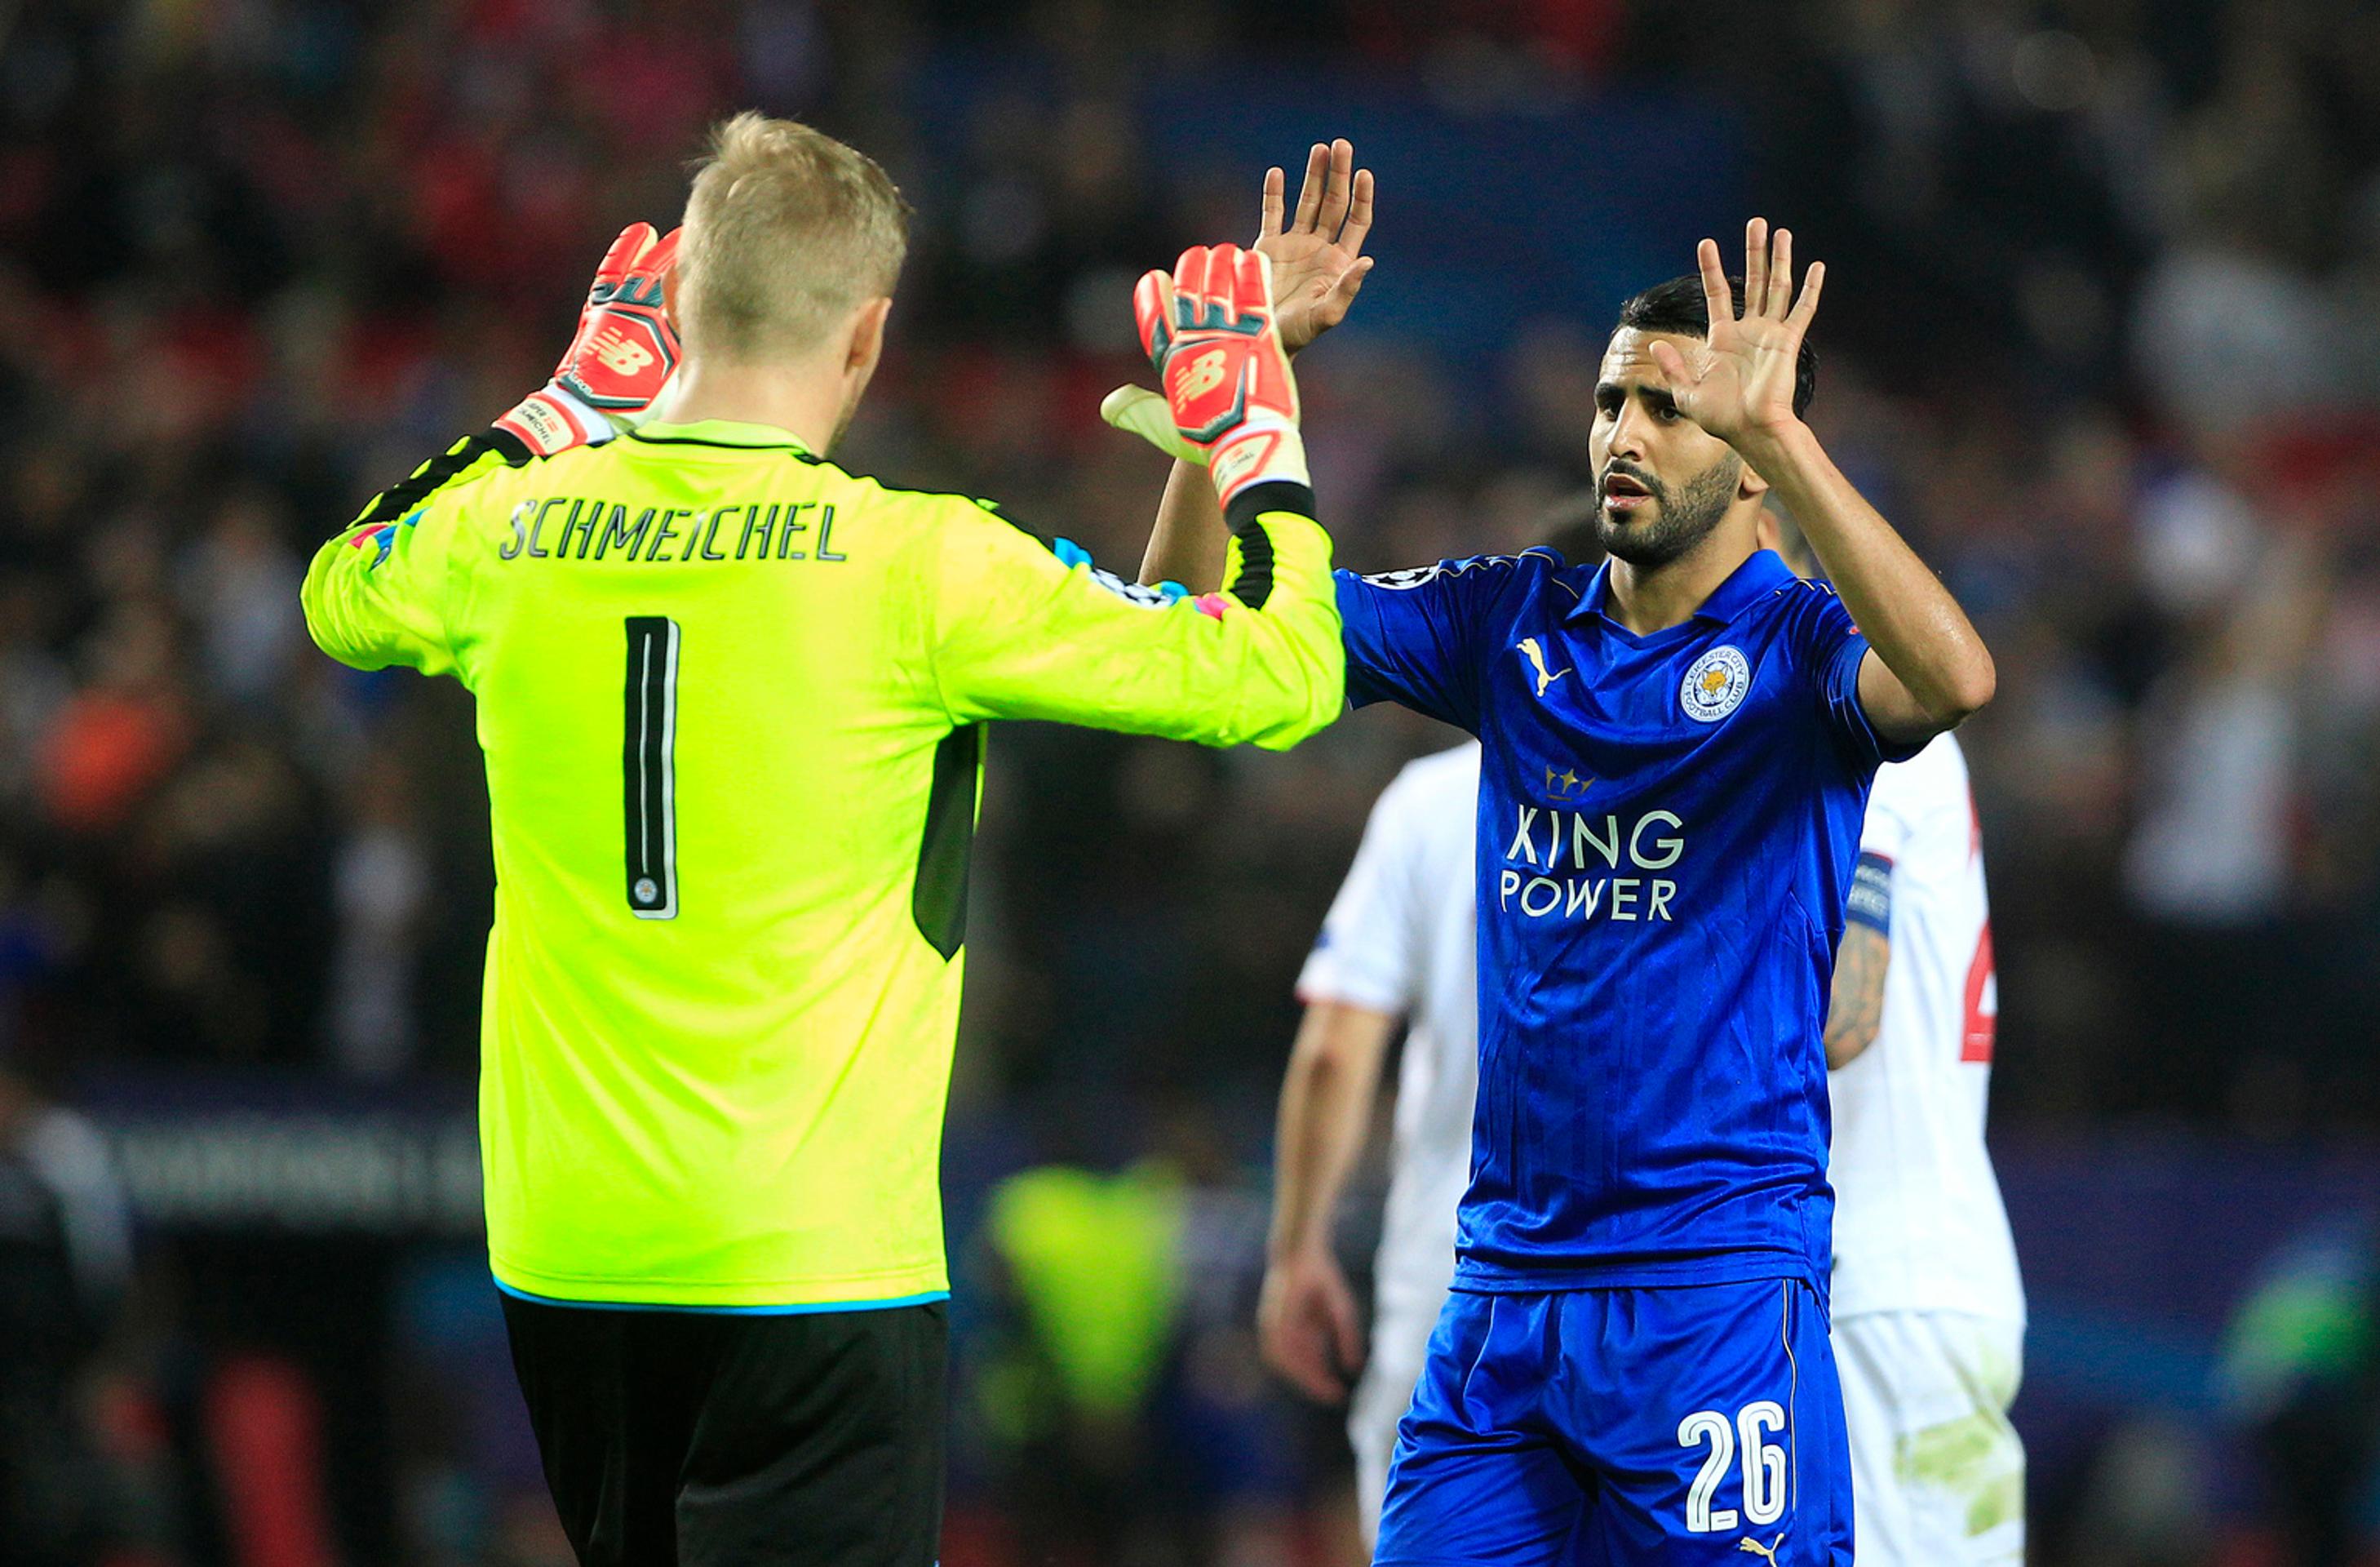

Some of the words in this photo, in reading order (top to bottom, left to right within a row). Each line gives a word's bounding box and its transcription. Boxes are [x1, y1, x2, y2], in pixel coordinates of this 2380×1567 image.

[499, 496, 847, 562] SCHMEICHEL
[1724, 681, 1745, 709] CLUB
[1731, 655, 1744, 677] CITY
[623, 615, 680, 920] 1
[1506, 803, 1684, 870] KING
[1500, 869, 1677, 921] POWER
[1678, 1400, 1786, 1533] 26
